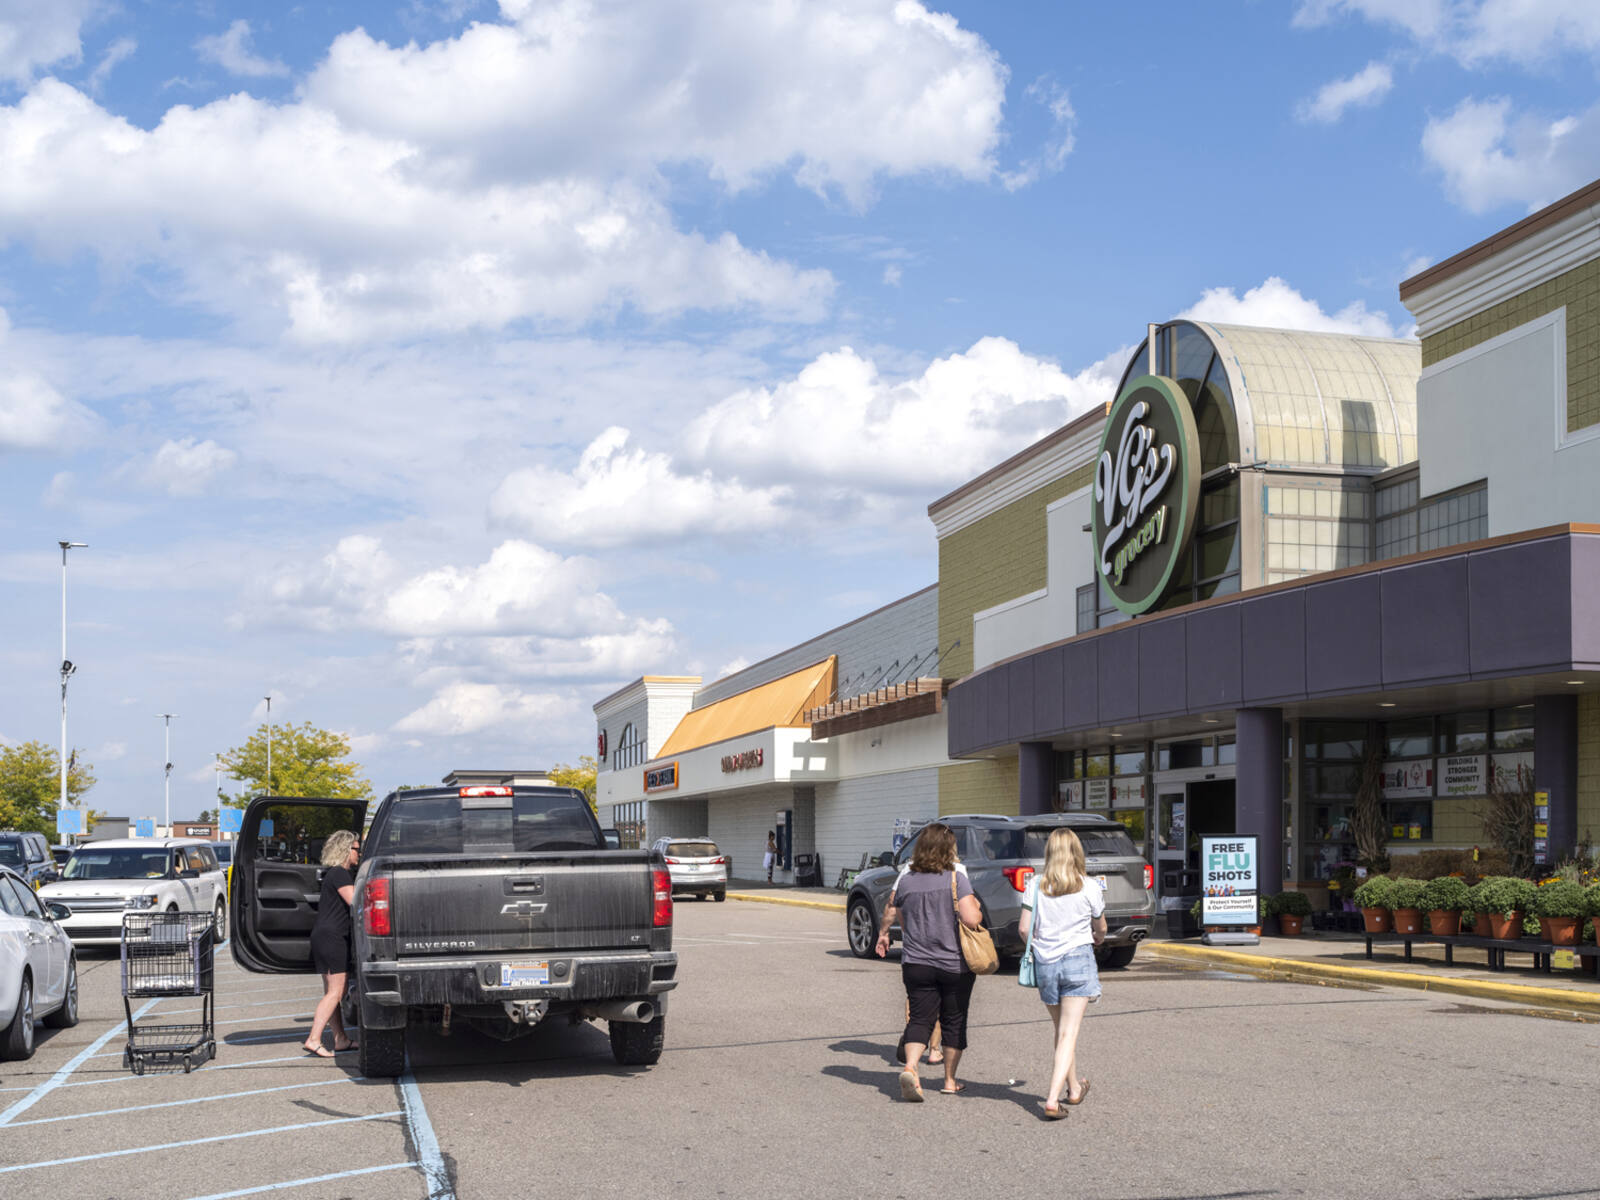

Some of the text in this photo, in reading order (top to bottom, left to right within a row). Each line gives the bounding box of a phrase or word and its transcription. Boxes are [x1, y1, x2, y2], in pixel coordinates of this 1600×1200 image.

[1114, 504, 1168, 587] grocery
[1448, 766, 1478, 774] STRONGER
[1444, 775, 1480, 784] COMMUNITY
[1212, 843, 1244, 853] FREE
[1208, 853, 1250, 870] FLU
[1208, 871, 1252, 881] SHOTS
[405, 941, 476, 950] SILVERADO
